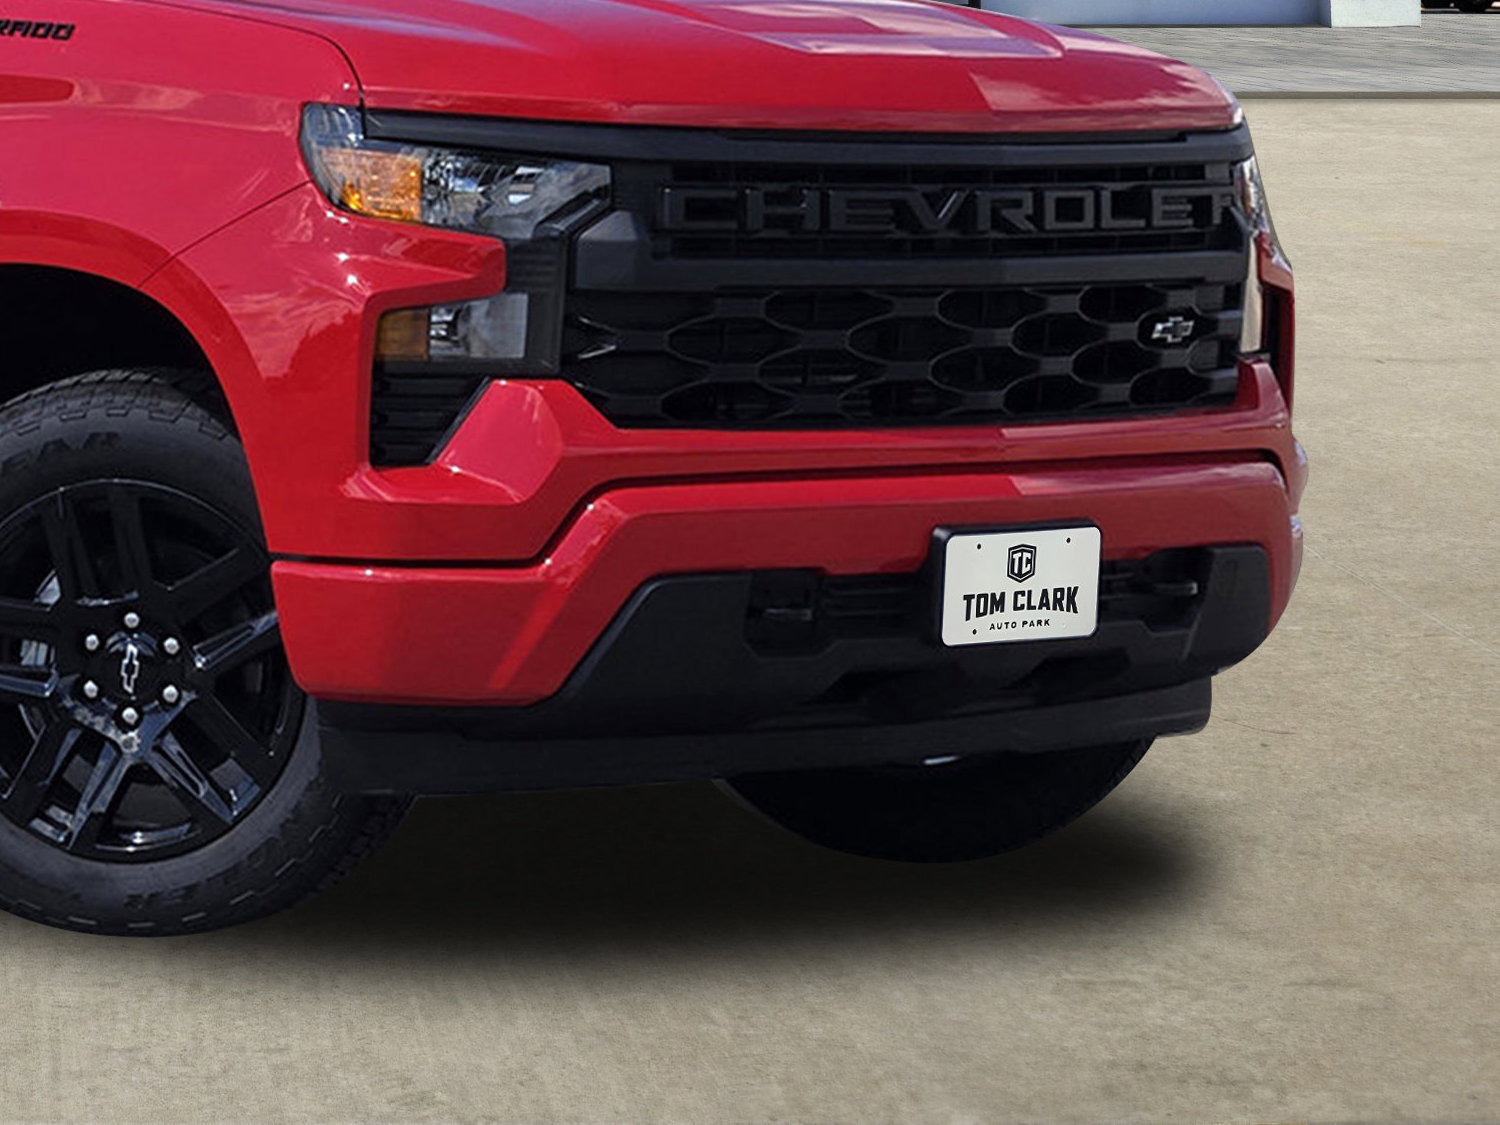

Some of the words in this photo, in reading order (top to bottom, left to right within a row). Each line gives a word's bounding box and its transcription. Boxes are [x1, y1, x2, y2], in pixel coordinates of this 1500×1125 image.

[962, 591, 1006, 622] TOM
[1012, 585, 1080, 614] CLARK
[989, 621, 1017, 631] AUTO
[1021, 618, 1051, 628] PARK
